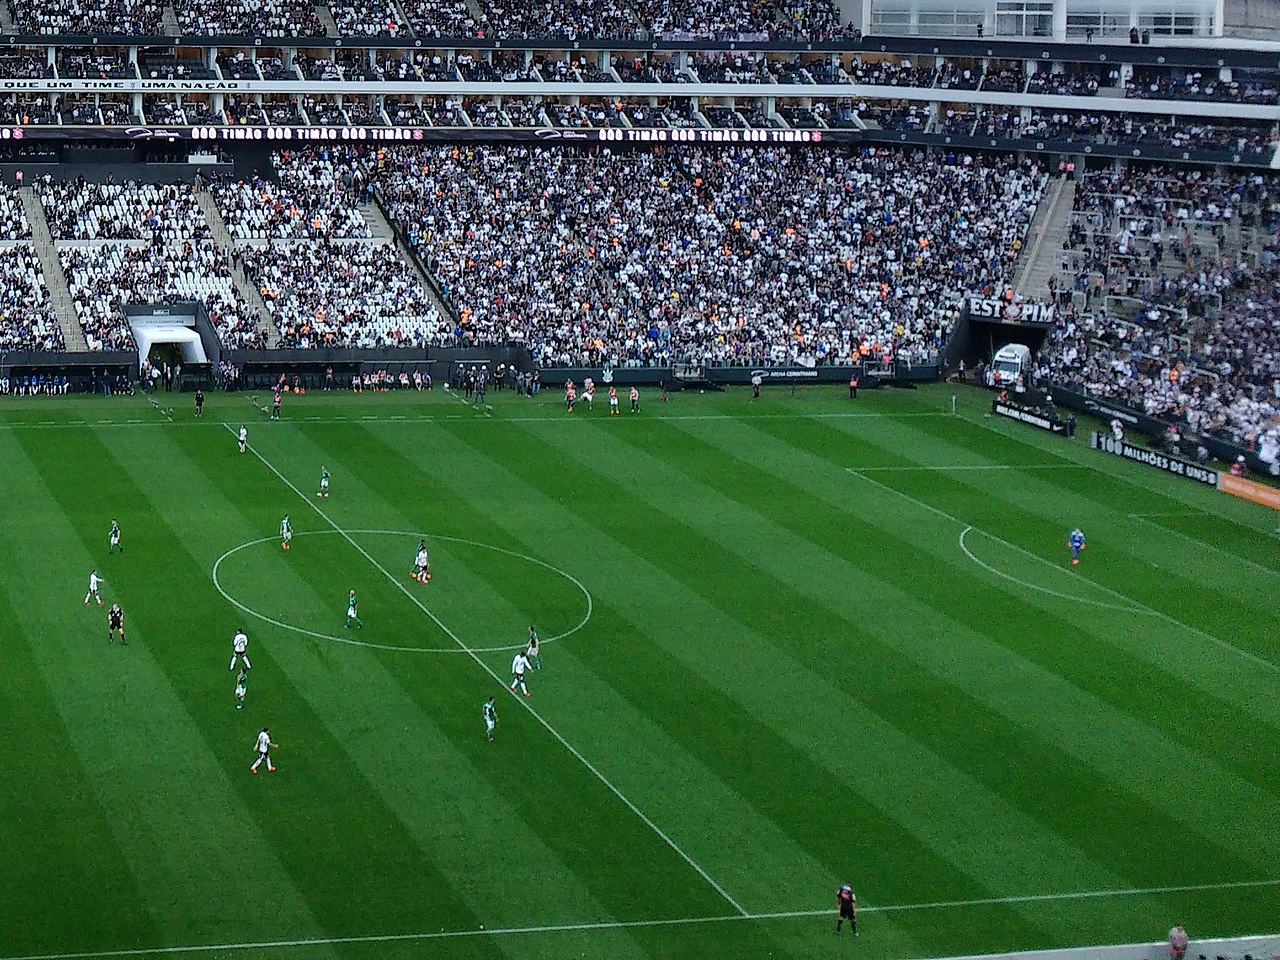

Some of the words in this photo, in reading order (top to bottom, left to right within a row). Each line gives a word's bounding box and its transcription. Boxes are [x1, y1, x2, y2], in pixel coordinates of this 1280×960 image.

[4, 81, 40, 89] QUE
[81, 81, 125, 89] TIME
[221, 127, 262, 140] TIMÃO
[296, 127, 337, 140] TIMÃO
[371, 127, 411, 140] TIMÃO
[627, 128, 667, 141] TIMÃO
[700, 128, 739, 141] TIMÃO
[771, 128, 811, 141] TIMÃO
[1099, 436, 1123, 456] 100
[1124, 445, 1169, 469] MILHÕES
[1169, 460, 1185, 475] DE
